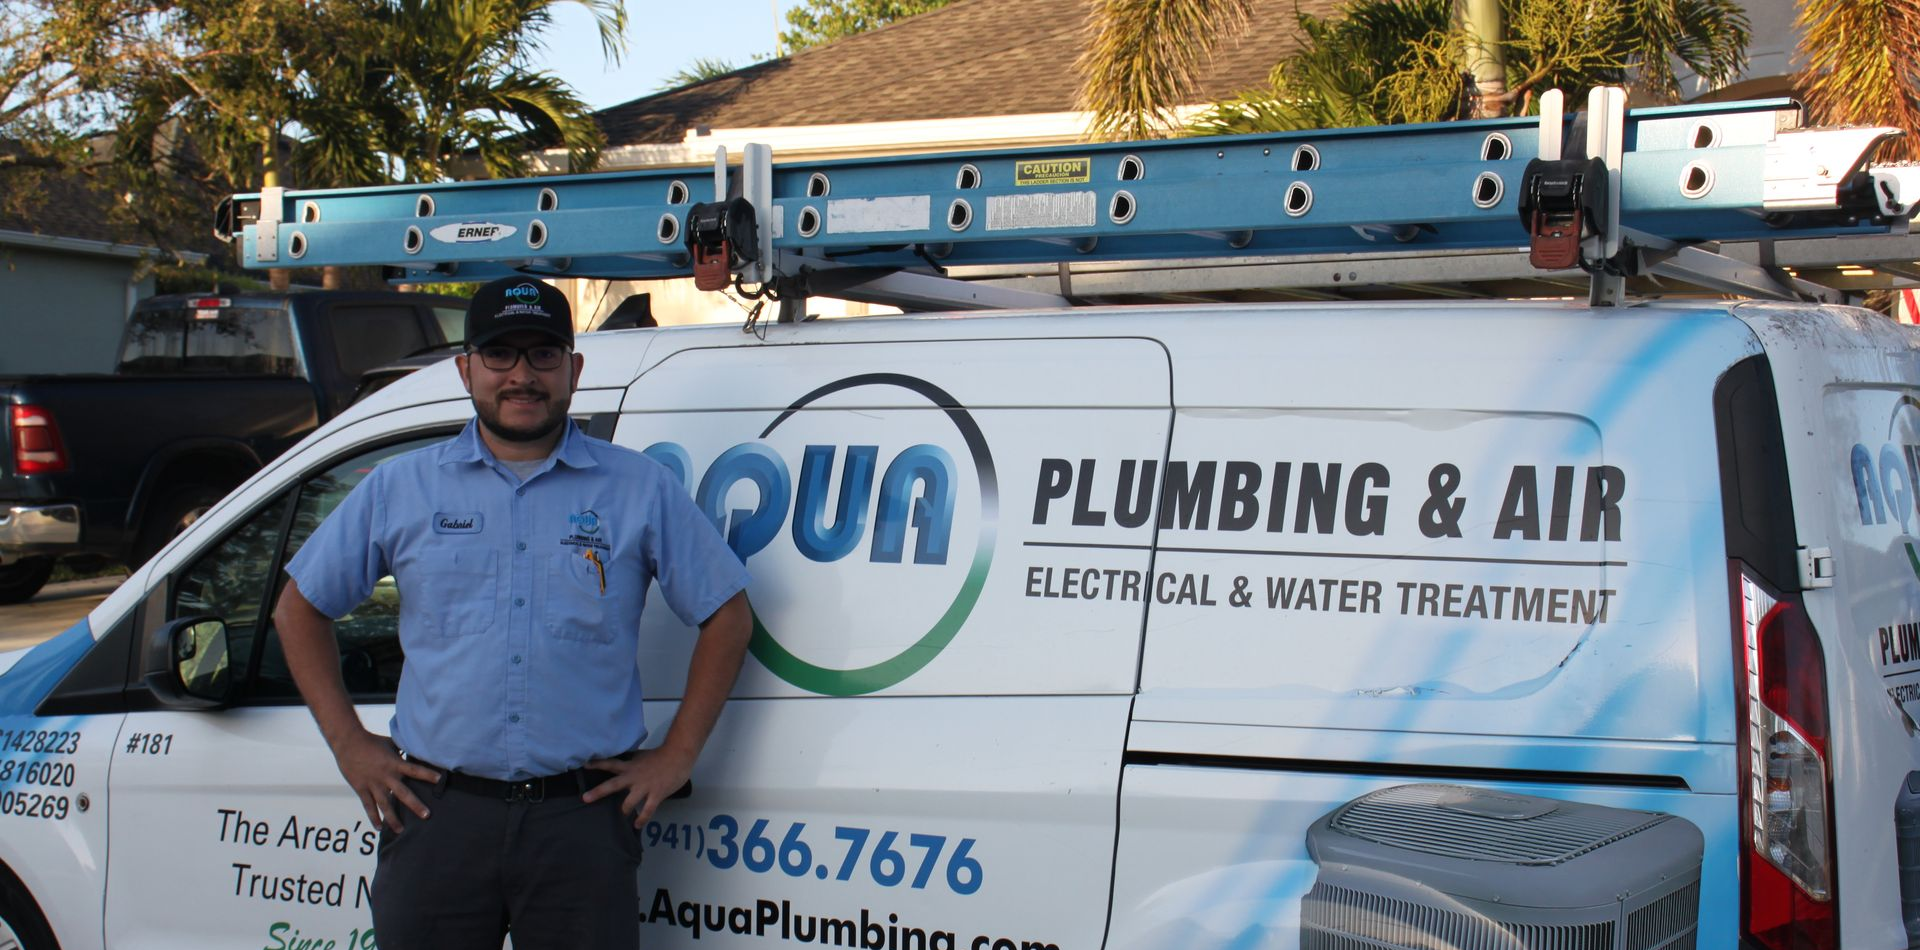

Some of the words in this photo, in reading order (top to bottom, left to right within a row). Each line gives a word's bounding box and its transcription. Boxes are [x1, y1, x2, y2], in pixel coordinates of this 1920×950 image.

[1023, 162, 1081, 174] CAUTION
[1032, 458, 1390, 536] PLUMBING
[1418, 463, 1466, 538] &
[1493, 465, 1626, 542] AIR
[1025, 566, 1217, 606] ELECTRICAL
[1229, 576, 1253, 607] &
[1266, 577, 1382, 613] WATER
[1397, 582, 1617, 625] TREATMENT
[126, 733, 173, 755] #181
[0, 759, 75, 787] 816020
[0, 790, 70, 820] 05269
[217, 809, 269, 846] The
[277, 815, 376, 856] Area's
[232, 863, 345, 907] Trusted
